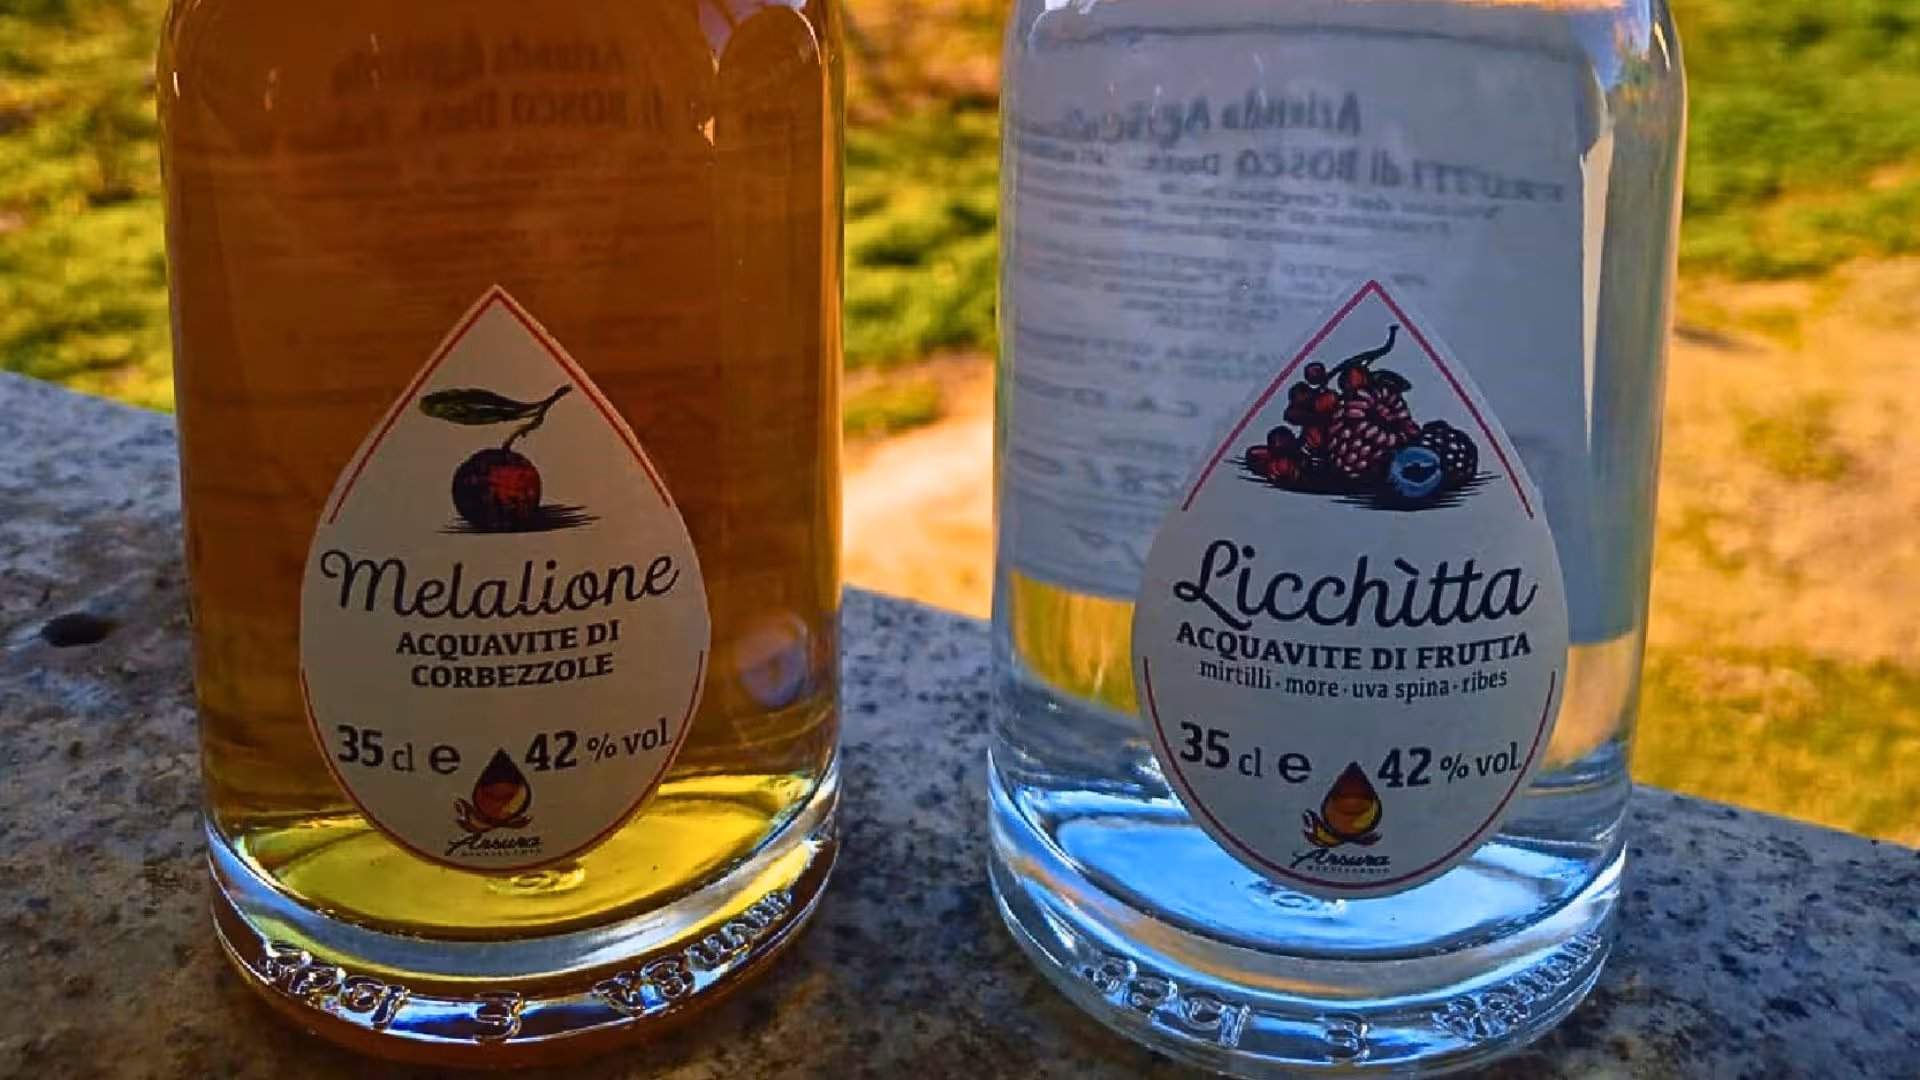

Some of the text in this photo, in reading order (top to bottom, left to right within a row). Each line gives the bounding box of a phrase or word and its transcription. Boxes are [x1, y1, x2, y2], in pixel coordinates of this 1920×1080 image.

[320, 549, 680, 620] Melalione
[1173, 540, 1539, 631] Licchìtta
[396, 619, 619, 660] ACQUAVITE DI
[1176, 622, 1532, 670] ACQUAVITE DI FRUTTA
[412, 653, 614, 688] CORBEZZOLE
[337, 725, 384, 767] 35
[393, 743, 413, 773] cl
[525, 729, 577, 771] 42
[1179, 722, 1230, 768] 35
[1239, 747, 1261, 778] cl
[1378, 747, 1431, 788] 42
